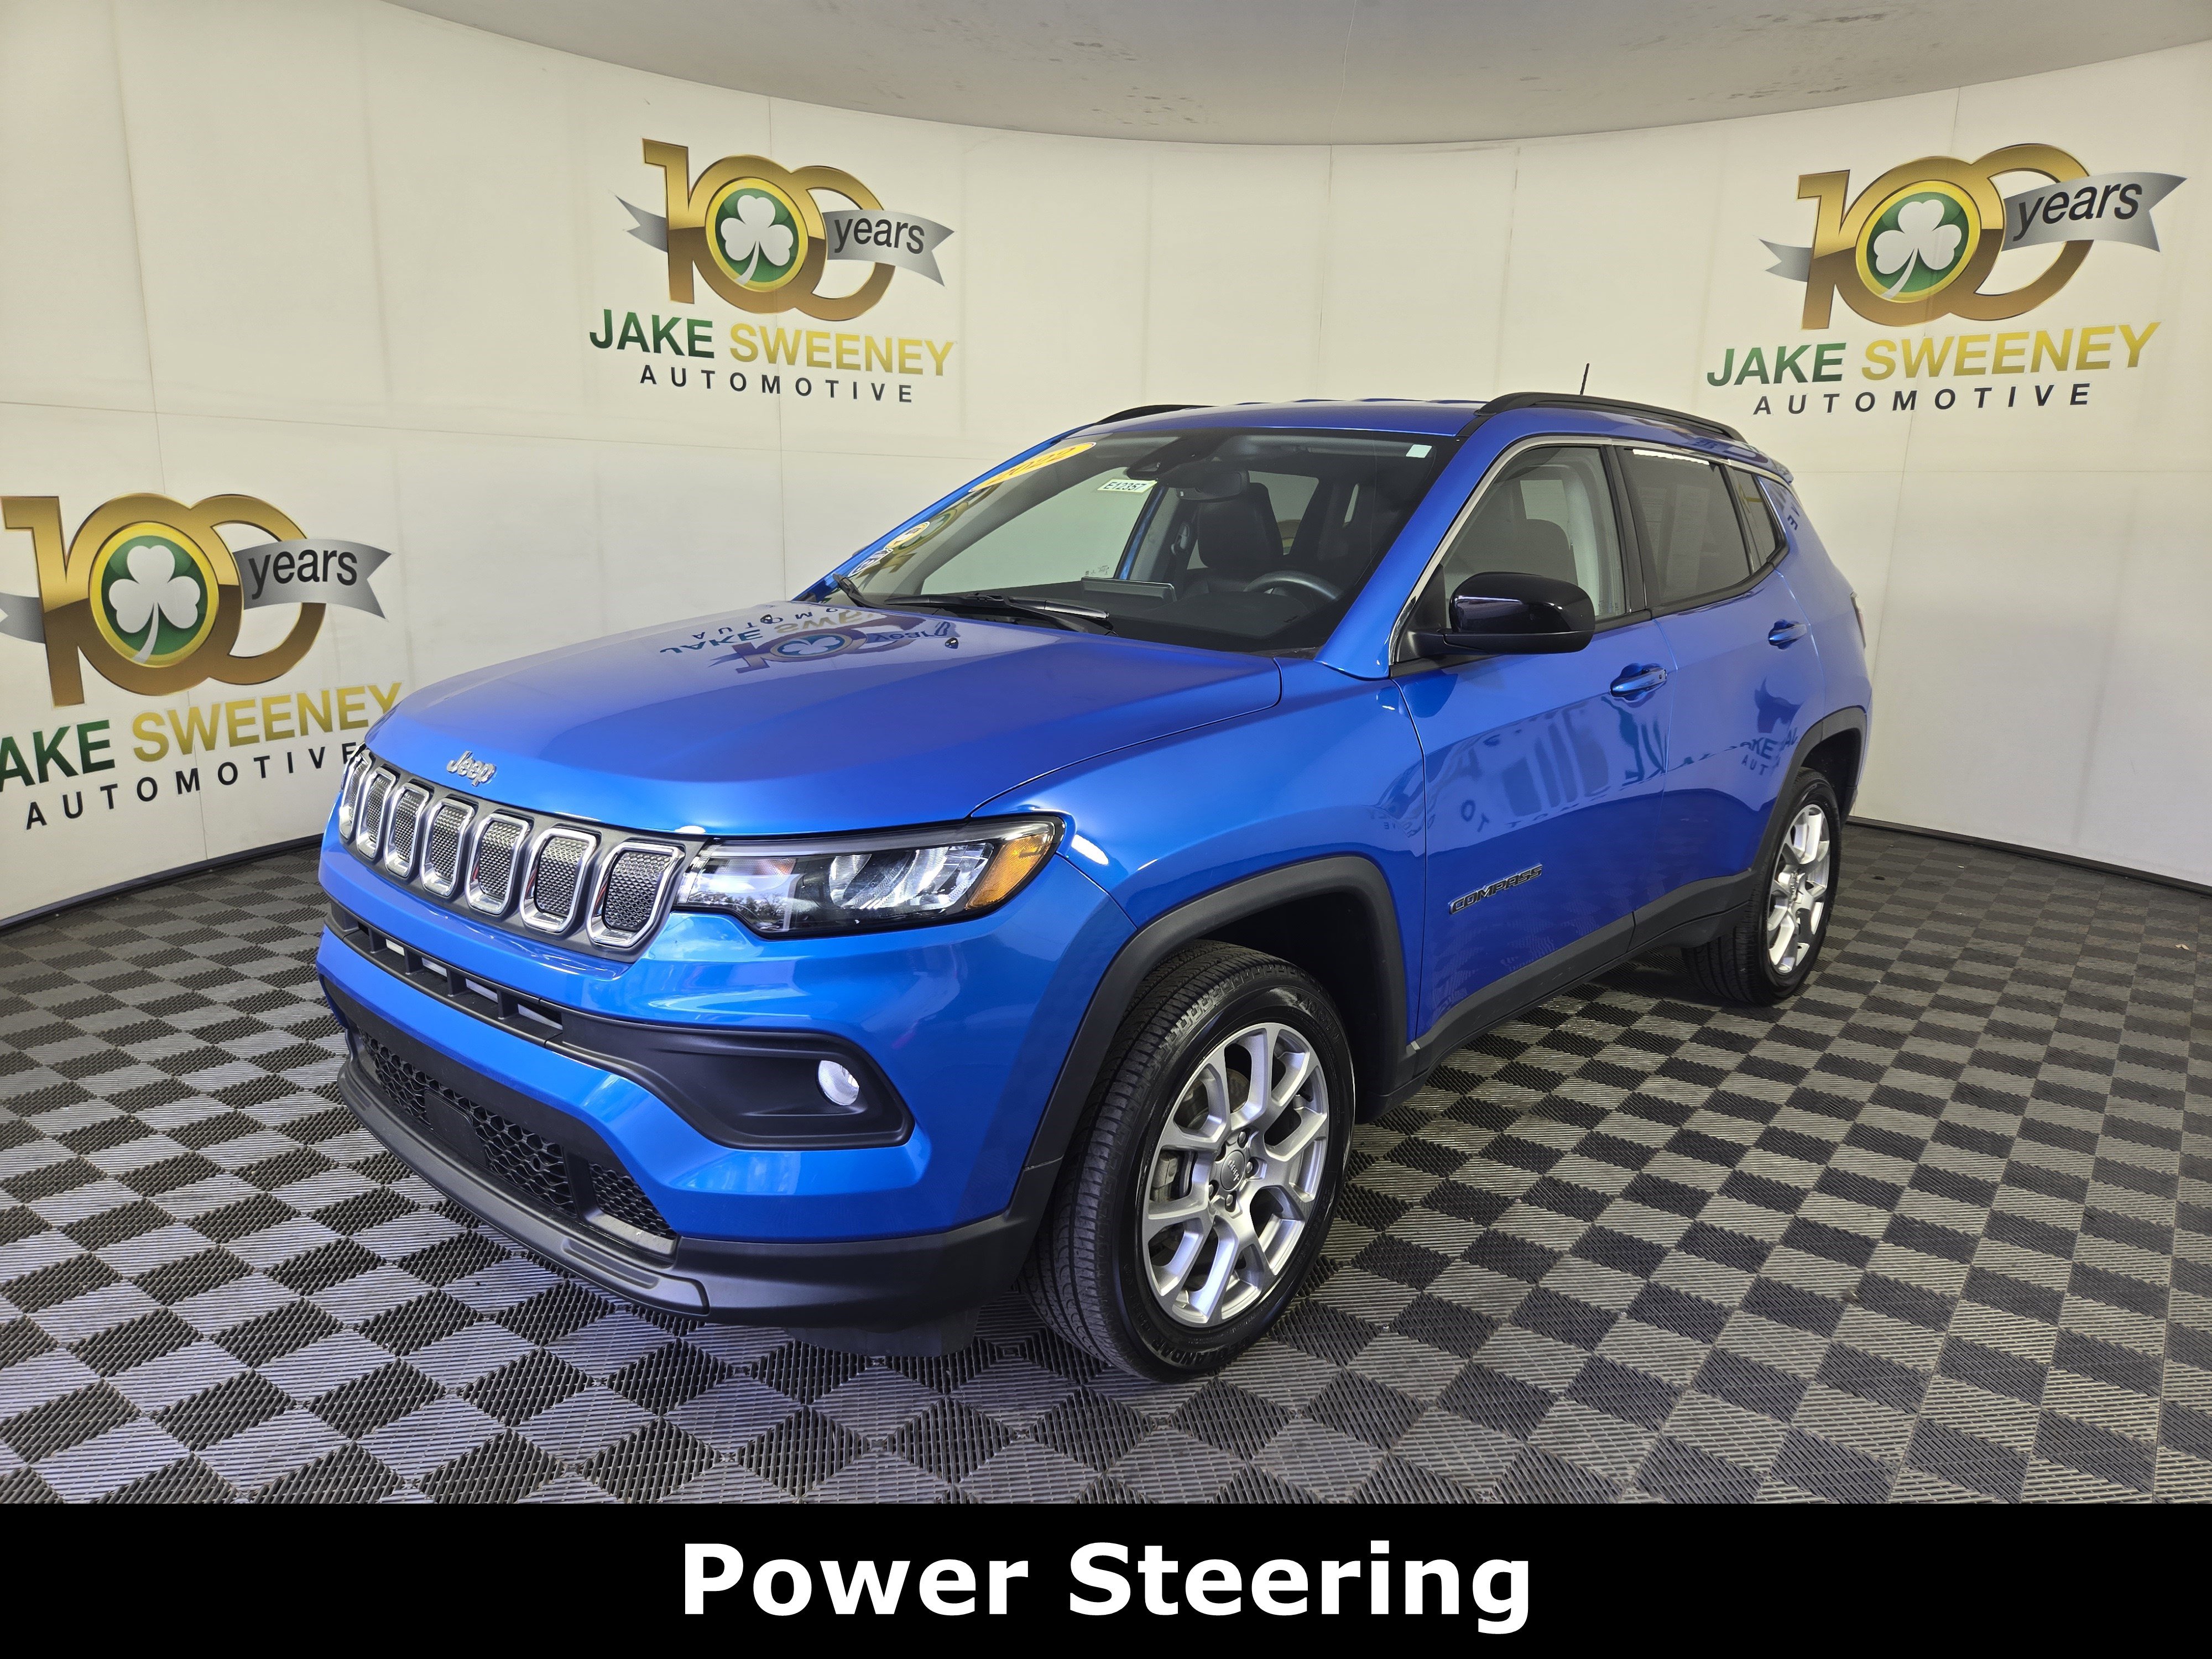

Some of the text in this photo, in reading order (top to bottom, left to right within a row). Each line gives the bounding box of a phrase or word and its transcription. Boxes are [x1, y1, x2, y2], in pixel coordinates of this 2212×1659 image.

[642, 138, 926, 321] 100 years
[1796, 143, 2143, 330] 100 years
[589, 309, 954, 377] JAKE SWEENEY
[1707, 321, 2161, 387] JAKE SWEENEY
[640, 364, 912, 403] AUTOMOTIVE
[1753, 383, 2091, 415] AUTOMOTIVE
[1, 493, 358, 707] 100 years
[0, 719, 115, 792] AKE
[446, 750, 497, 786] Jeep
[1448, 863, 1543, 914] COMPASS
